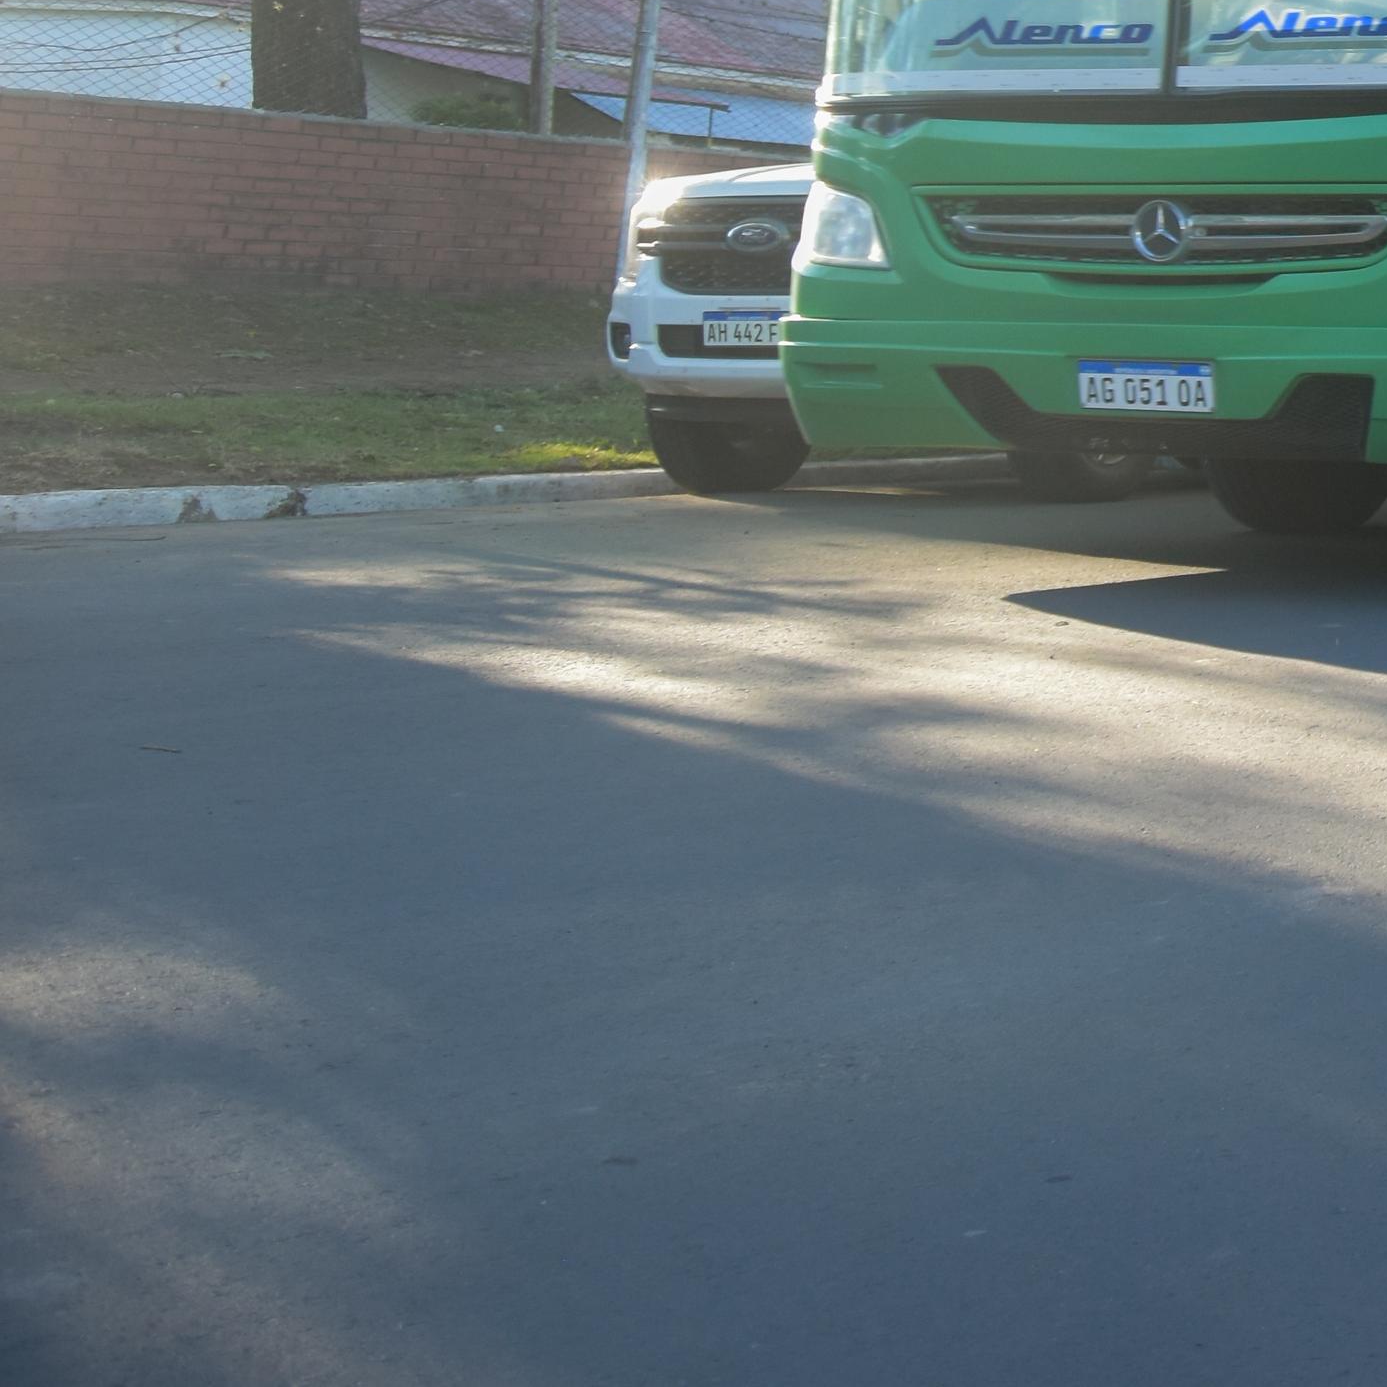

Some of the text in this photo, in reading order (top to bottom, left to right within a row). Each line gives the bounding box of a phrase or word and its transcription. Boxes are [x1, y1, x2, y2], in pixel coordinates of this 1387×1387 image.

[934, 16, 1155, 46] Alenco
[707, 323, 728, 343] AH
[733, 323, 764, 343] 442
[1086, 376, 1116, 404] AG
[1123, 377, 1168, 406] 051
